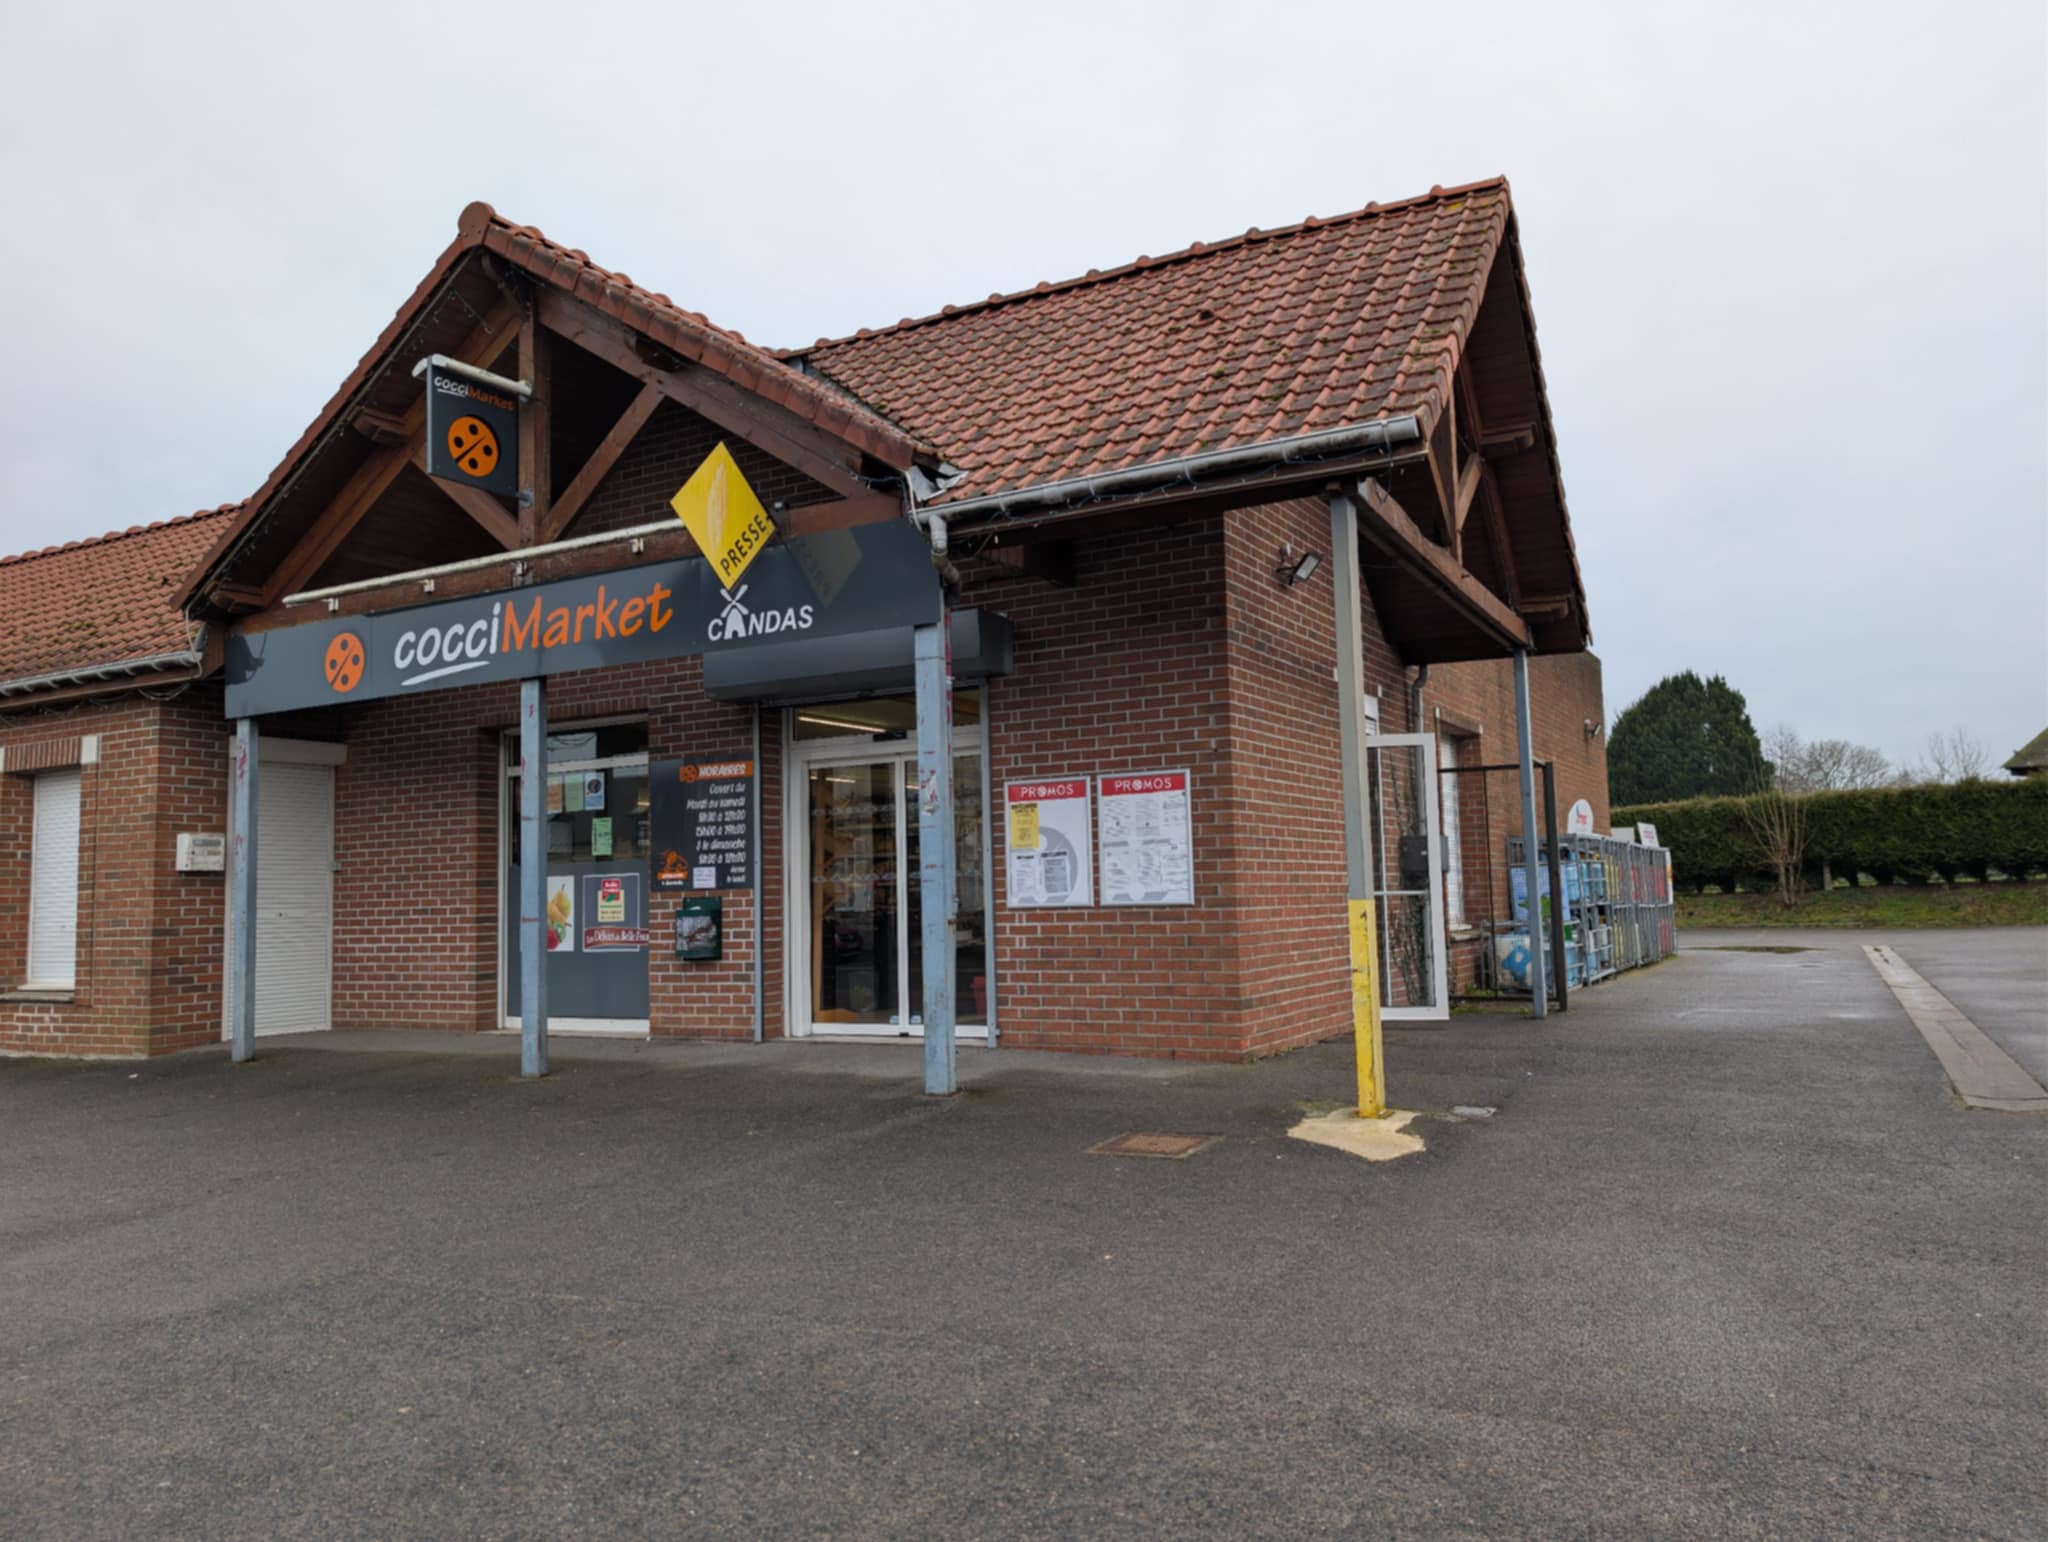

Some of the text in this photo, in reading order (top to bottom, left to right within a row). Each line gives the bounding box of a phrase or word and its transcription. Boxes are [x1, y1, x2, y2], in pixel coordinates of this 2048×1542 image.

[434, 376, 513, 412] cocciMarket
[720, 514, 767, 577] PRESSE
[393, 582, 674, 669] cocciMarket
[708, 604, 814, 641] CANDAS
[1020, 784, 1074, 798] PROMOS
[1115, 777, 1173, 791] PROMOS
